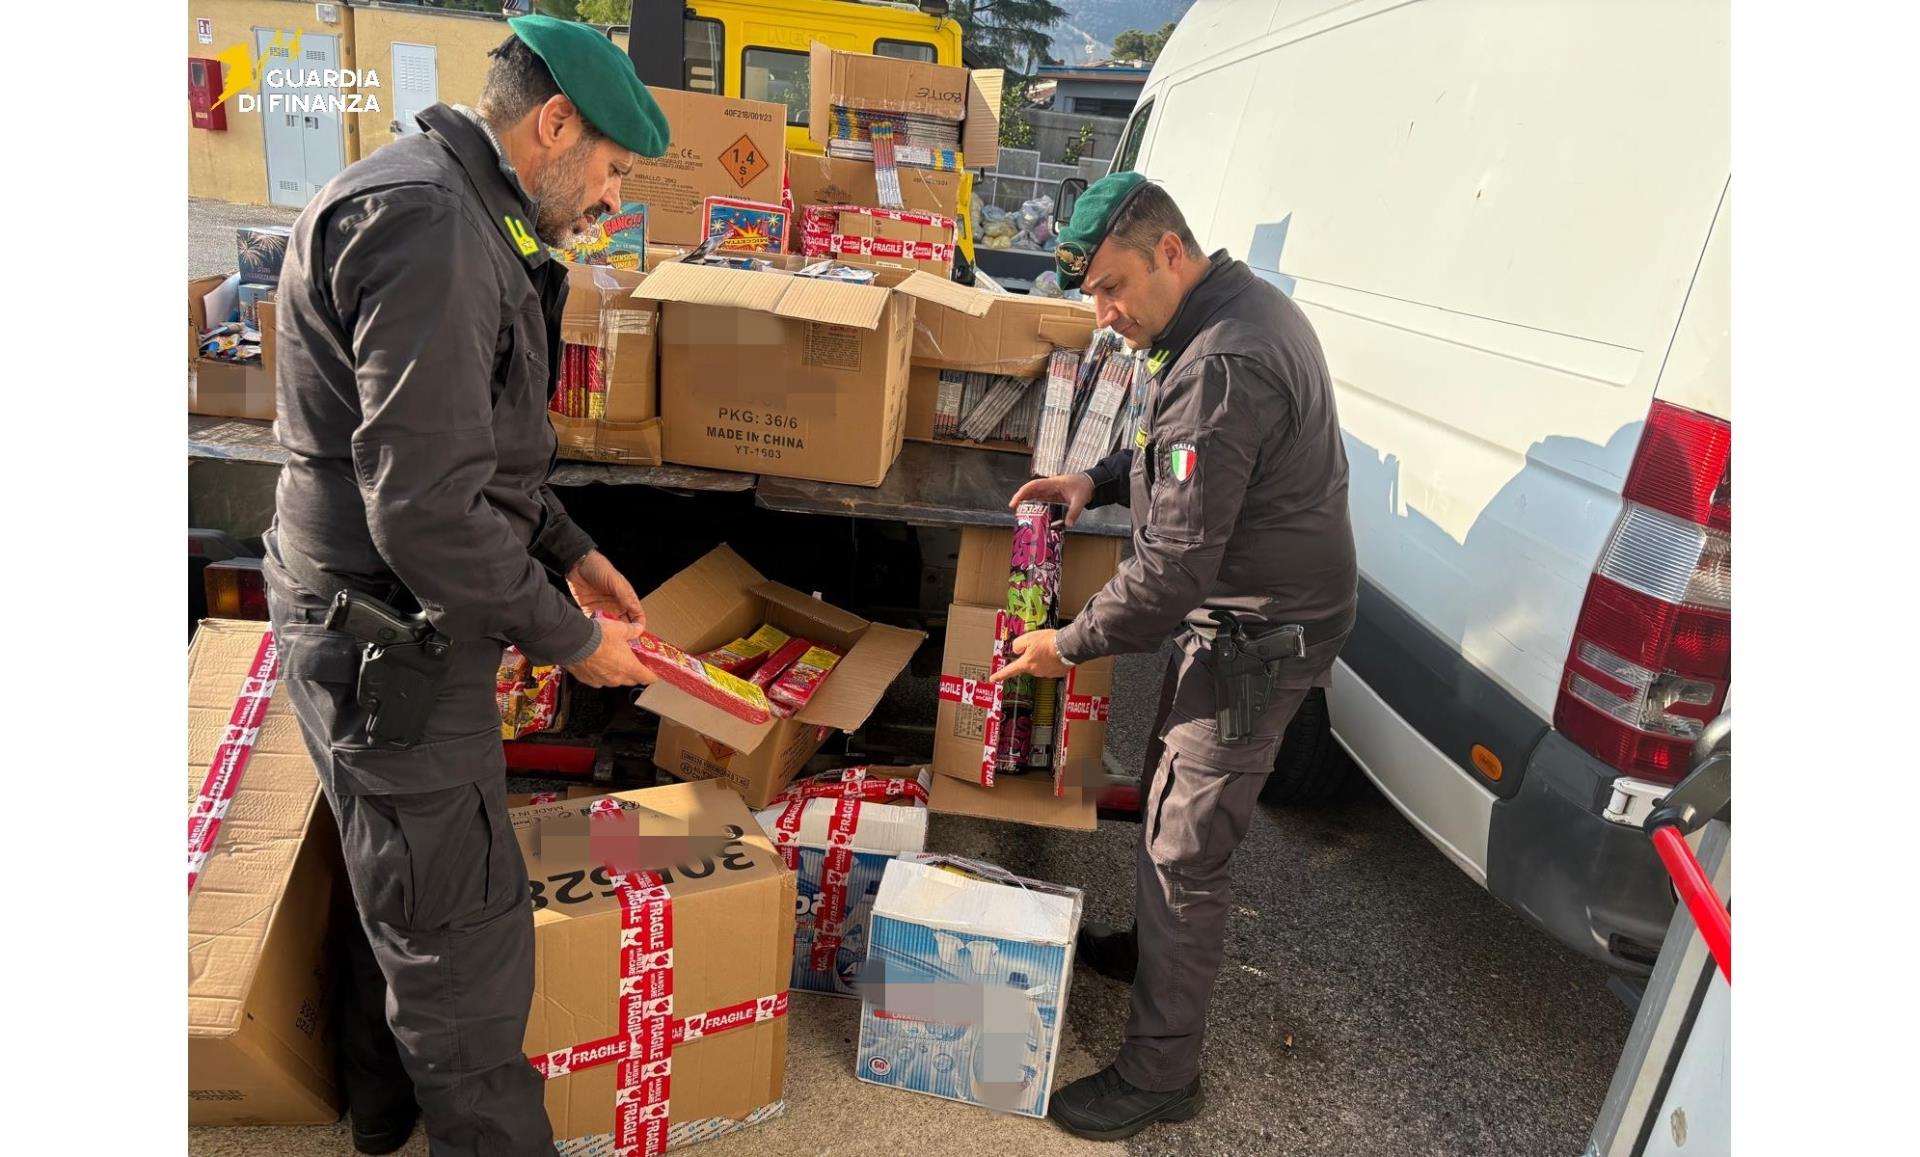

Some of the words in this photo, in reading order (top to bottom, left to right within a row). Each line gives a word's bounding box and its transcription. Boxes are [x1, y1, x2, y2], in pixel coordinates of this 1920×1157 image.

[732, 148, 755, 166] 1.4
[739, 167, 748, 176] S
[872, 242, 902, 253] FRAGILE
[718, 407, 760, 425] PKG:
[765, 413, 798, 429] 36/6
[706, 425, 742, 441] MADE
[746, 431, 760, 442] IN
[763, 433, 804, 450] CHINA
[1171, 443, 1196, 453] ITALIA
[1067, 702, 1091, 714] FRAGILE
[648, 901, 665, 950] FRAGILE
[705, 1008, 754, 1030] FRAGILE
[650, 1016, 665, 1060] FRAGILE
[572, 1040, 627, 1066] FRAGILE
[623, 1102, 638, 1145] FRAGILE
